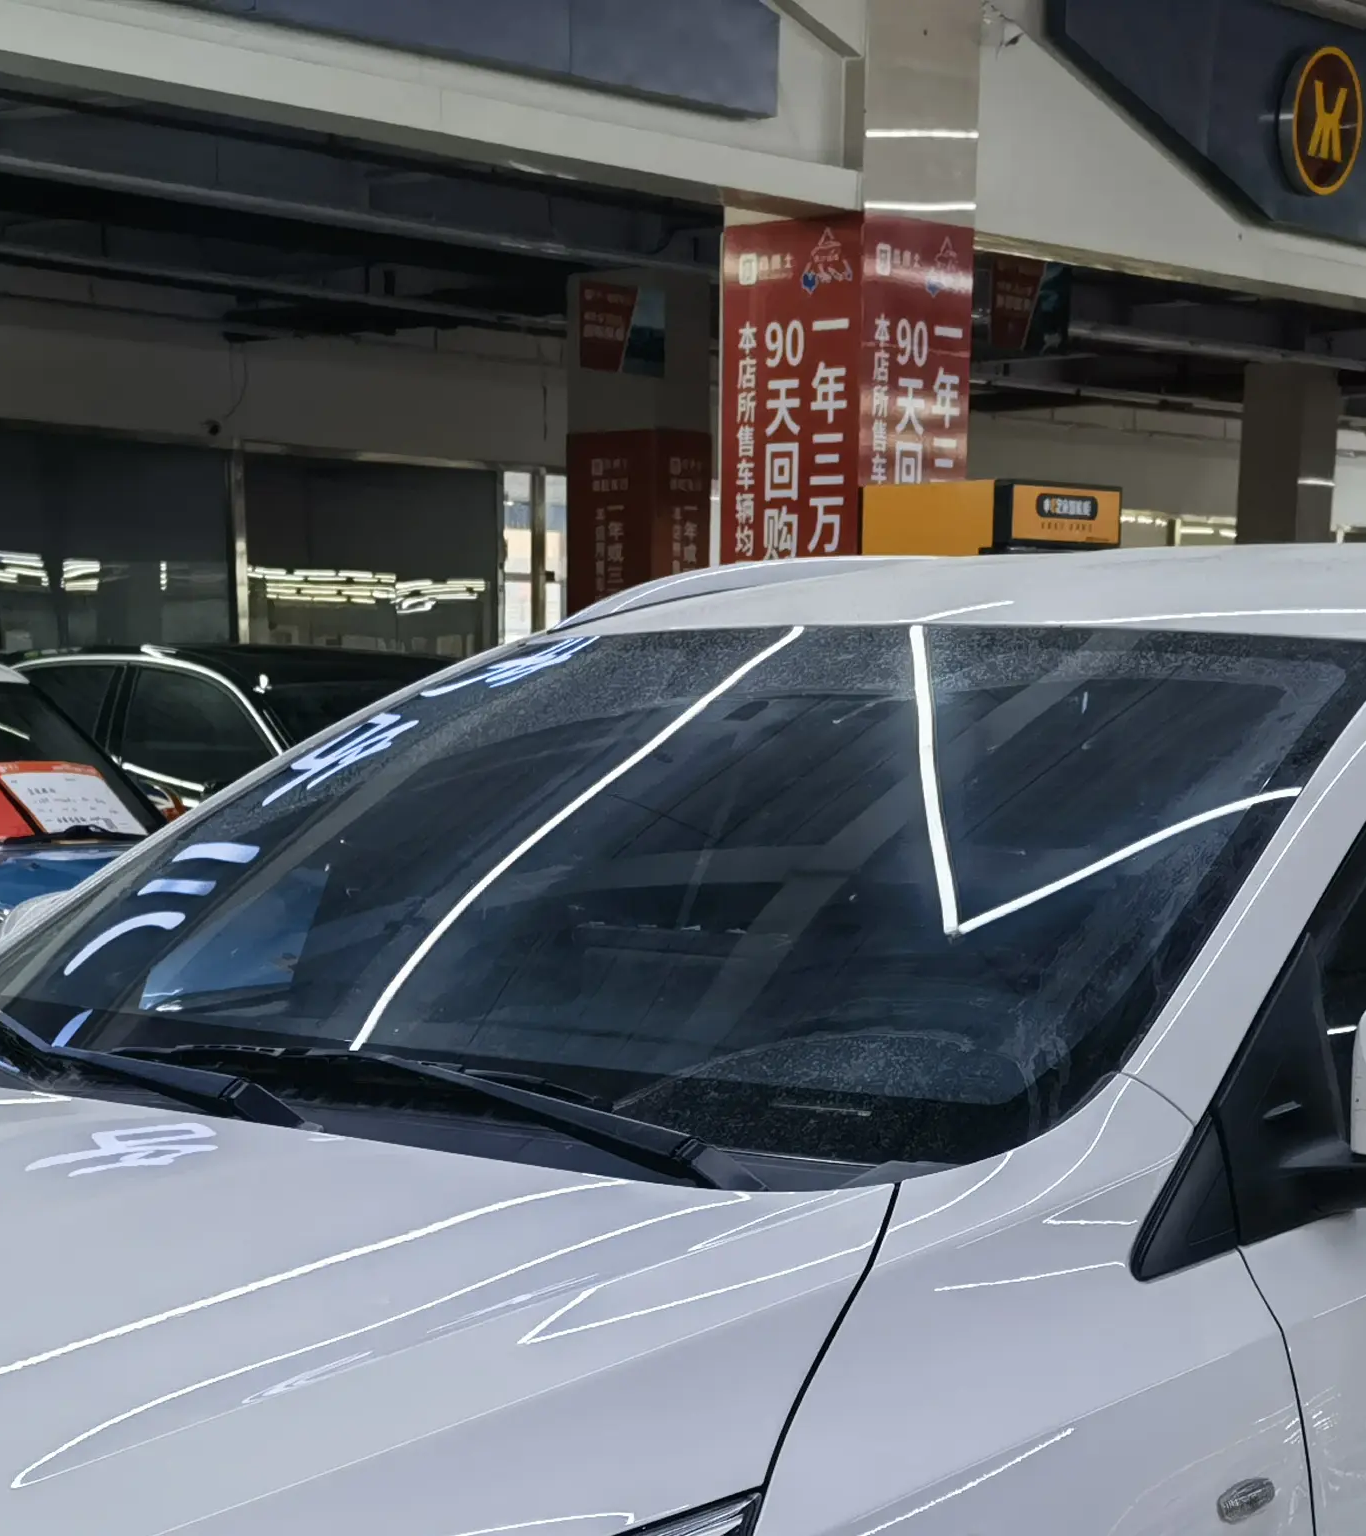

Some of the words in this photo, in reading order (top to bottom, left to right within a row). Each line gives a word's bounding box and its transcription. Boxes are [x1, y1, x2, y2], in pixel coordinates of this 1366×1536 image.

[735, 321, 759, 557] 本店所售车辆均
[763, 320, 806, 561] 90天回购
[807, 318, 850, 553] 一年三万
